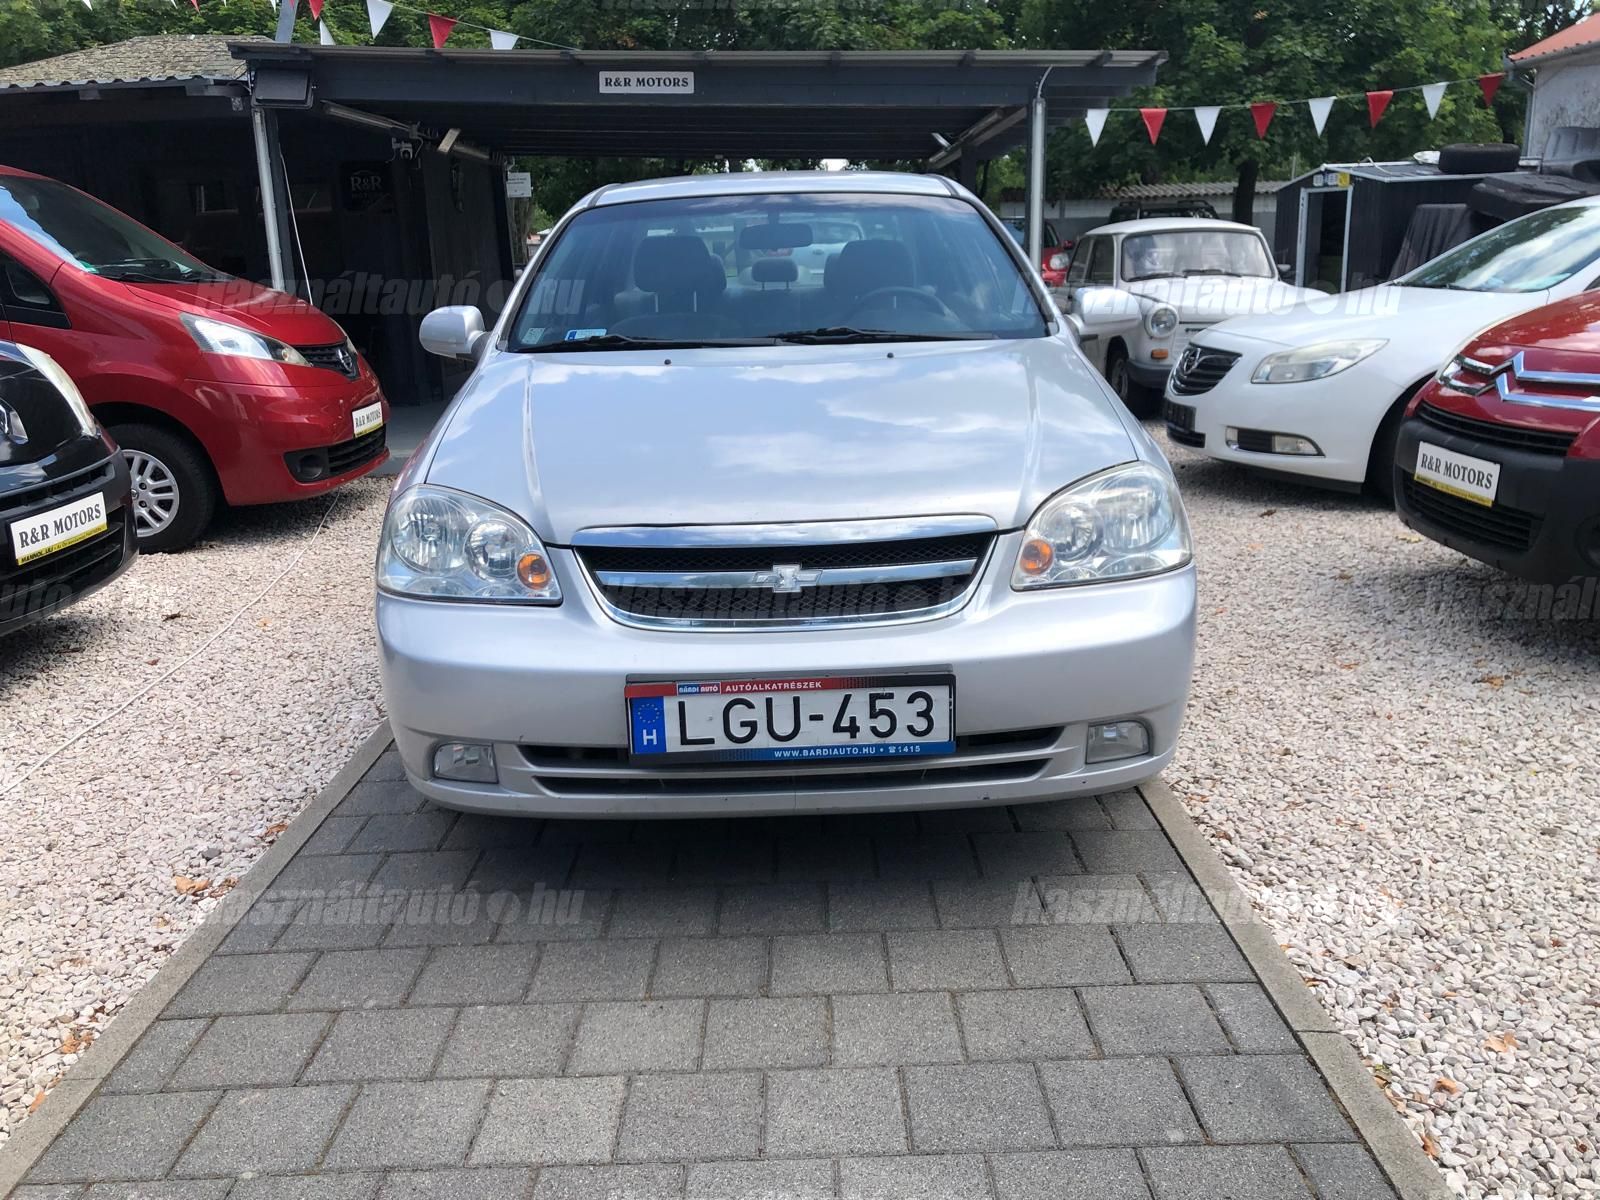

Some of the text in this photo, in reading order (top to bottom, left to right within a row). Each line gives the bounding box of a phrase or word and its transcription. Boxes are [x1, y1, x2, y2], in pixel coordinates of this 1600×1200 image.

[604, 77, 689, 88] R&R MOTORS
[1421, 453, 1442, 474] R&R
[1443, 460, 1494, 490] MOTORS
[19, 523, 50, 549] R&R
[53, 503, 102, 536] MOTORS
[700, 684, 719, 693] AUTÓ
[725, 681, 822, 693] AUTÓALKATRÉSZEK
[642, 690, 936, 746] H LGU-453
[774, 746, 876, 758] WWW.BARDIAUTO.HU
